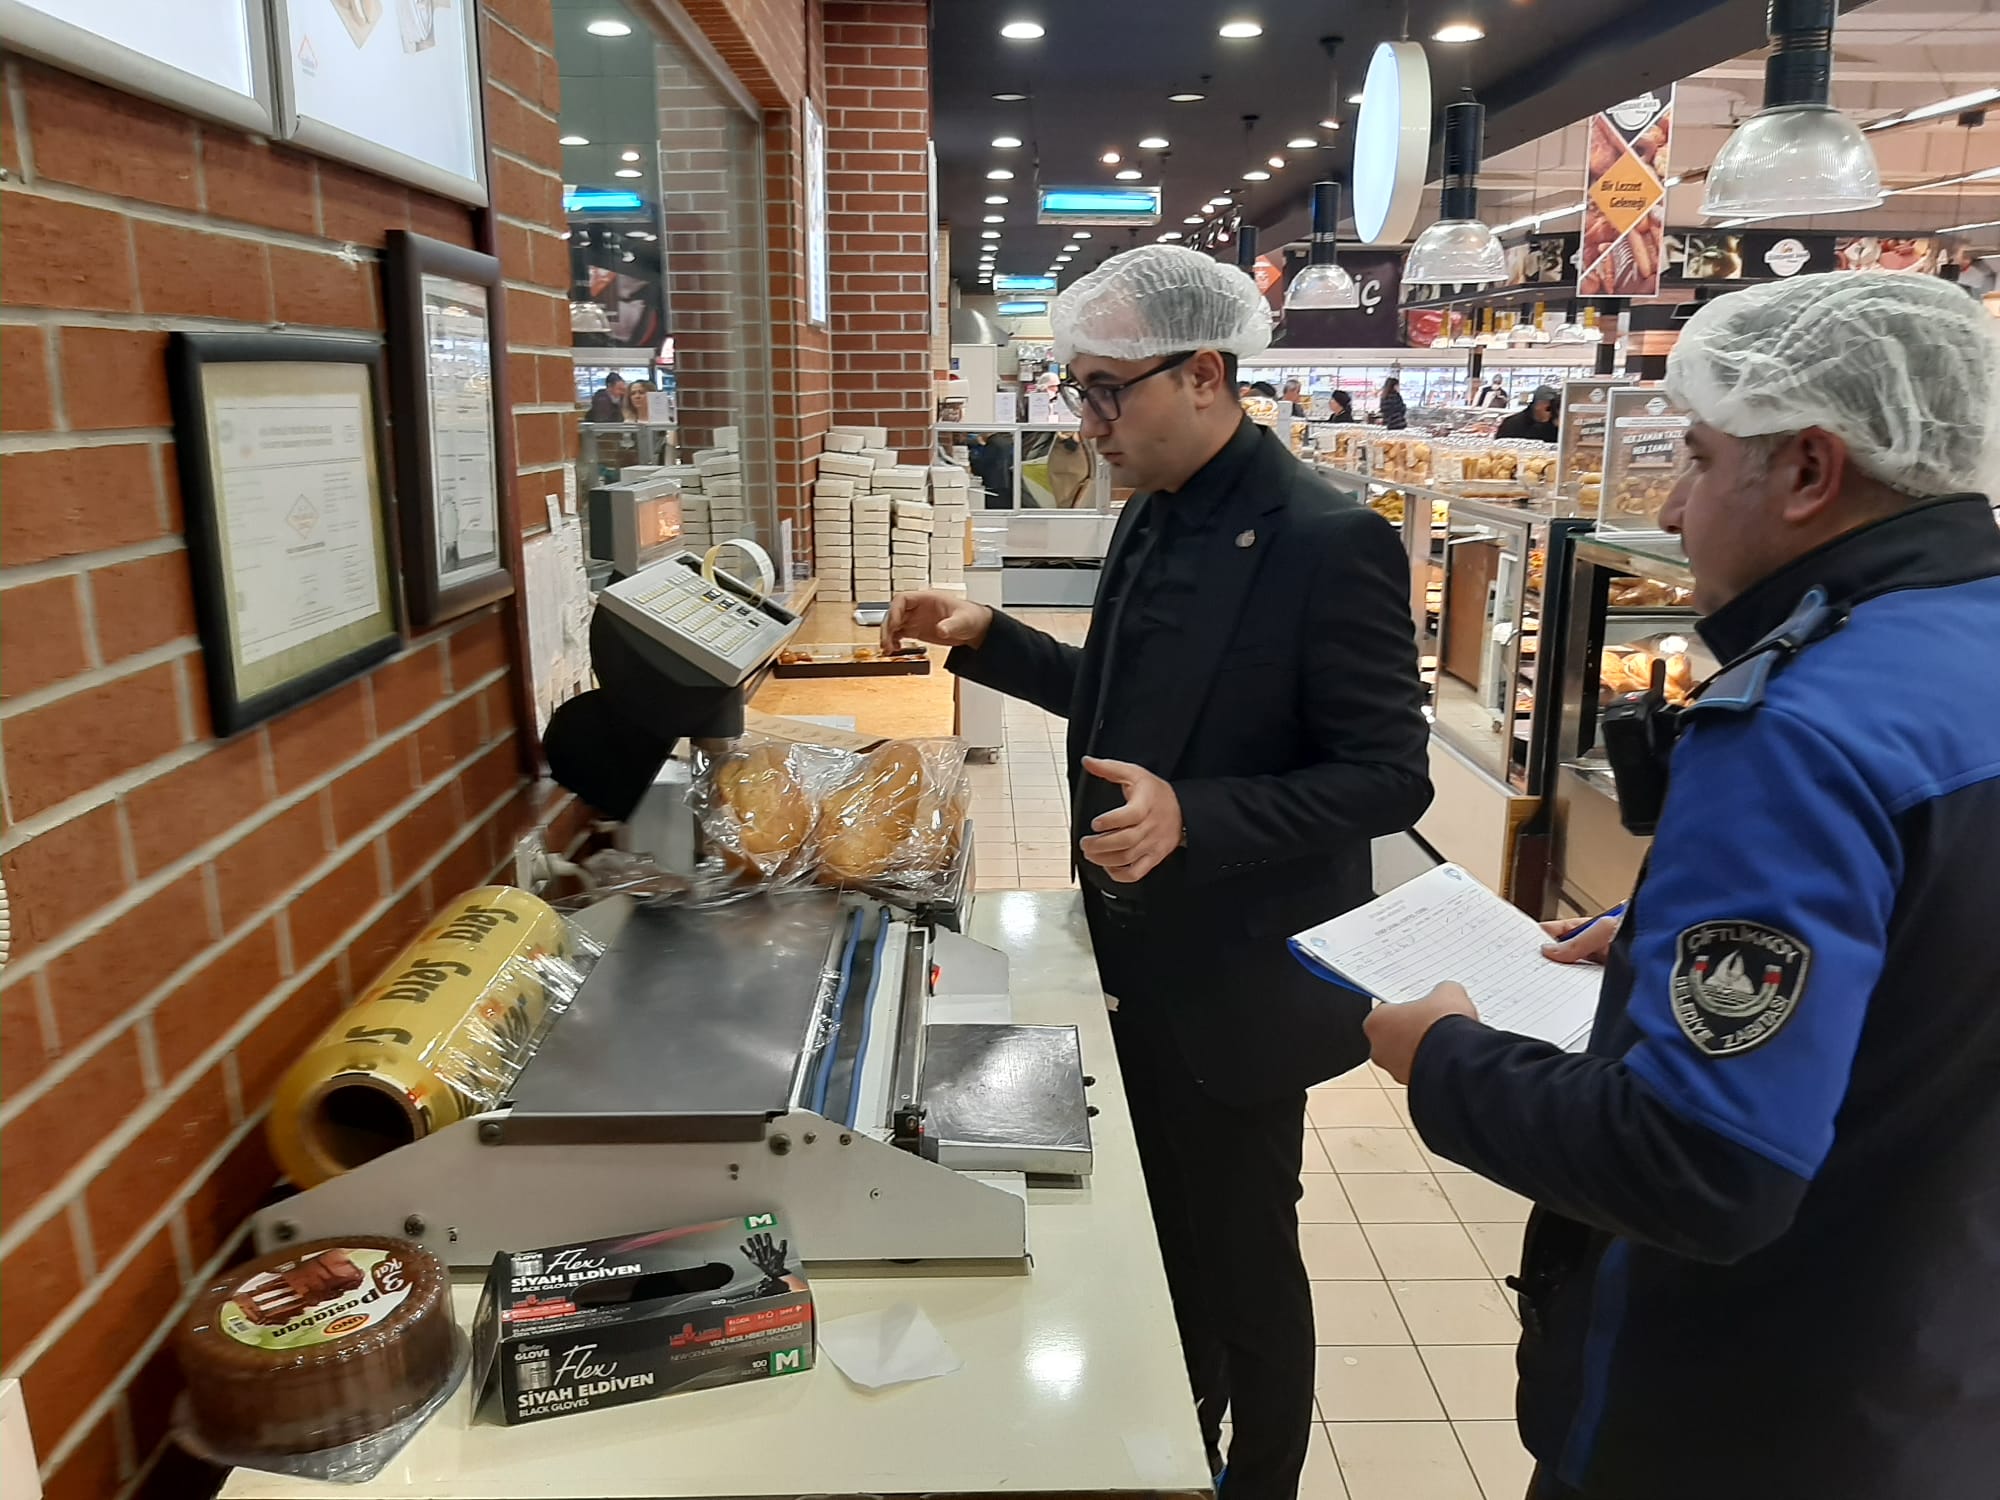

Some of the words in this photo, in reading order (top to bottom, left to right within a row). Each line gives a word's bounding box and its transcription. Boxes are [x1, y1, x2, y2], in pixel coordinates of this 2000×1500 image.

[1601, 181, 1614, 191] Bir
[1615, 181, 1642, 191] Lezzet
[1674, 976, 1715, 1043] BELEDİYE
[748, 1213, 773, 1228] M
[545, 1248, 606, 1274] Flex
[384, 1270, 405, 1292] 3
[511, 1273, 563, 1288] SİYAH
[568, 1264, 642, 1282] ELDİVEN
[511, 1285, 541, 1294] BLACK
[542, 1281, 579, 1291] GLOVES
[271, 1287, 381, 1338] Pastaban
[331, 1314, 365, 1332] UNO
[514, 1349, 550, 1361] GLOVE
[553, 1344, 618, 1386] Flex
[752, 1360, 768, 1368] 100
[775, 1349, 800, 1371] M
[518, 1387, 573, 1408] SİYAH
[578, 1372, 655, 1398] ELDİVEN
[519, 1406, 550, 1418] BLACK
[551, 1398, 590, 1412] GLOVES
